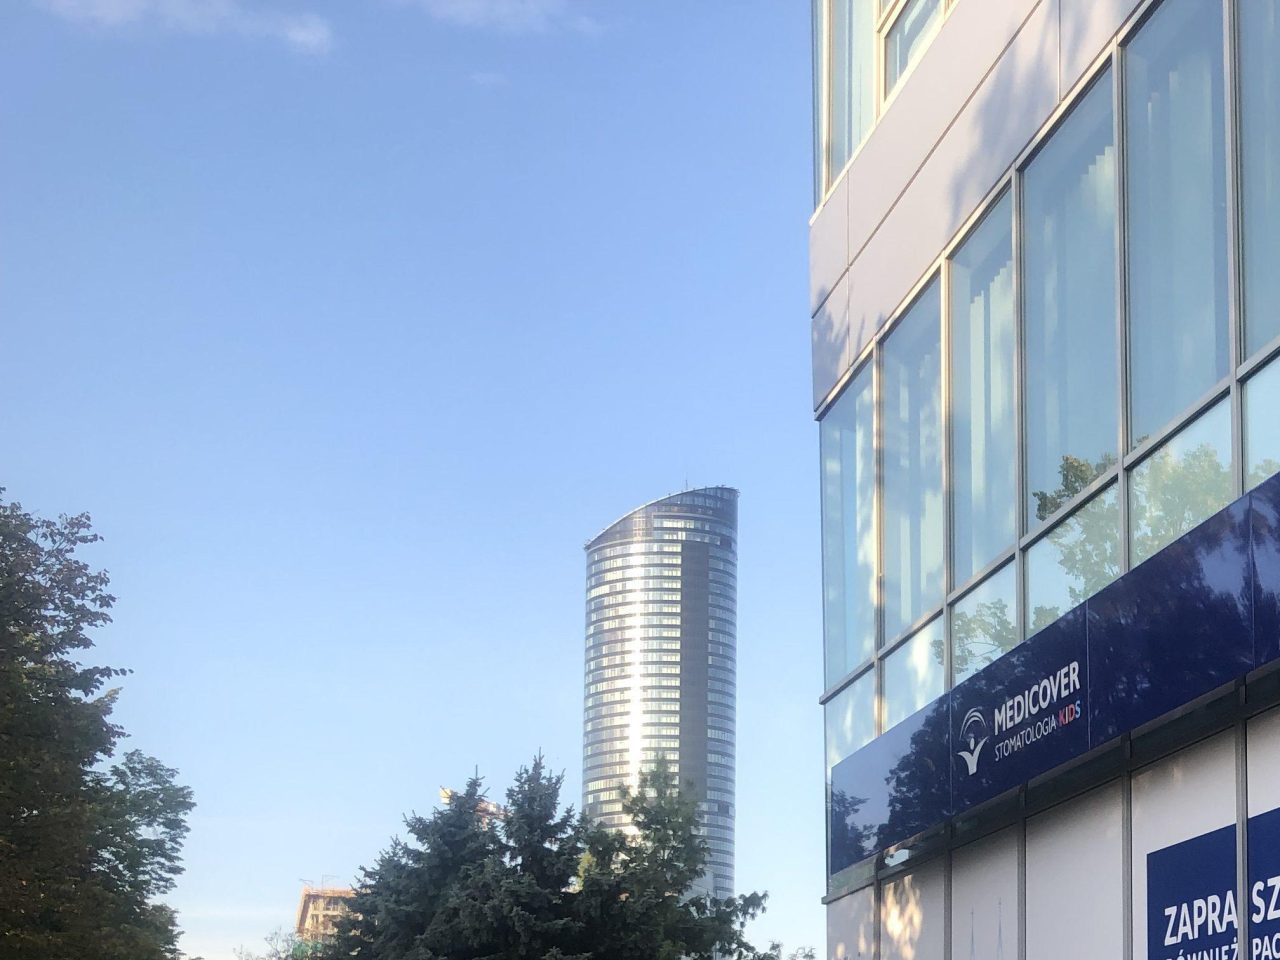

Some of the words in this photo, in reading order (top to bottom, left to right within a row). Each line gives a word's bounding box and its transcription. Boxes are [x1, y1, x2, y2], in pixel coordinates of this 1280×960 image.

[994, 661, 1081, 735] MEDICOVER
[994, 714, 1057, 761] STOMATOLOGIA
[1058, 700, 1081, 727] KIDS
